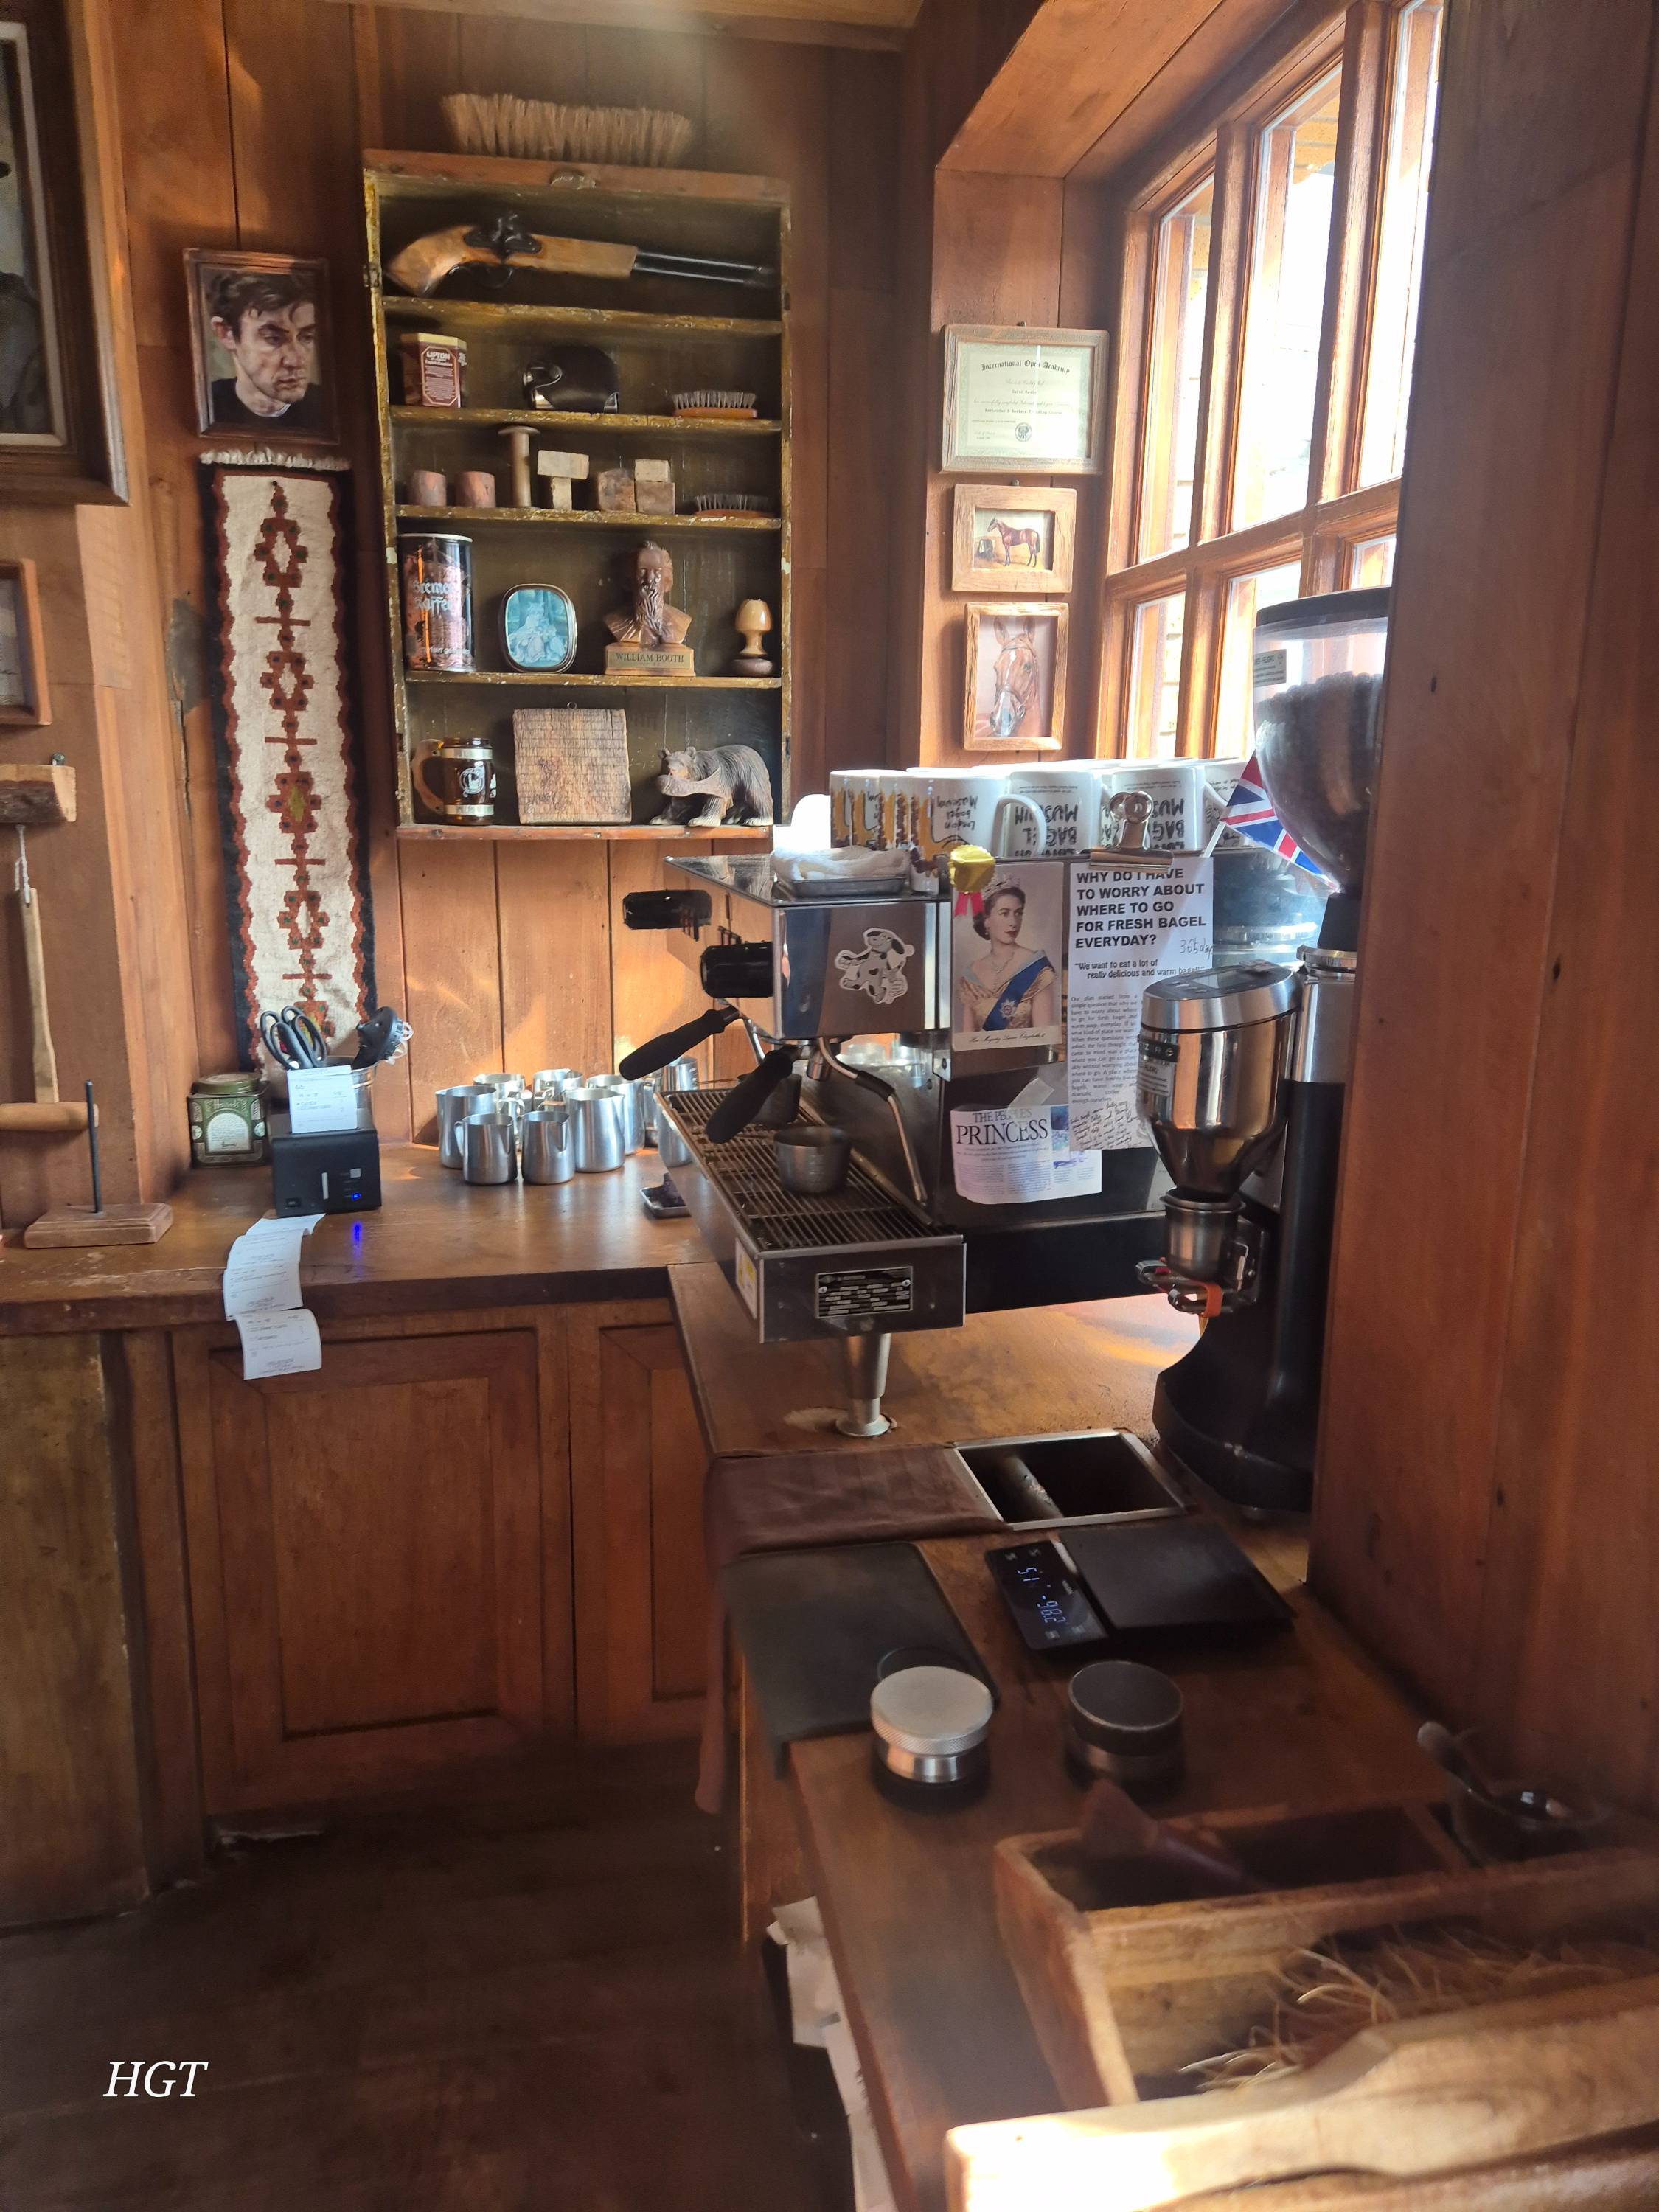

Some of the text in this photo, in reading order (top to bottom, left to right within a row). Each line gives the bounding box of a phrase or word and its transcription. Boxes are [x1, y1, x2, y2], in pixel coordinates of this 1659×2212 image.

[427, 351, 450, 360] LIPTON
[981, 360, 1022, 371] International
[1043, 362, 1070, 375] Academy
[616, 653, 653, 661] WILLIAM
[1077, 872, 1108, 883] WHY
[1113, 872, 1132, 881] DO
[1146, 869, 1183, 879] HAVE
[1077, 883, 1205, 900] TO WORRY ABOUT
[1077, 902, 1174, 916] WHERE TO GO
[1077, 917, 1206, 932] FOR FRESH BAGEL
[1075, 934, 1157, 948] EVERYDAY?
[1087, 970, 1106, 979] really
[1108, 970, 1139, 978] delicious
[973, 1111, 992, 1122] THE
[956, 1119, 1048, 1145] PRINCESS
